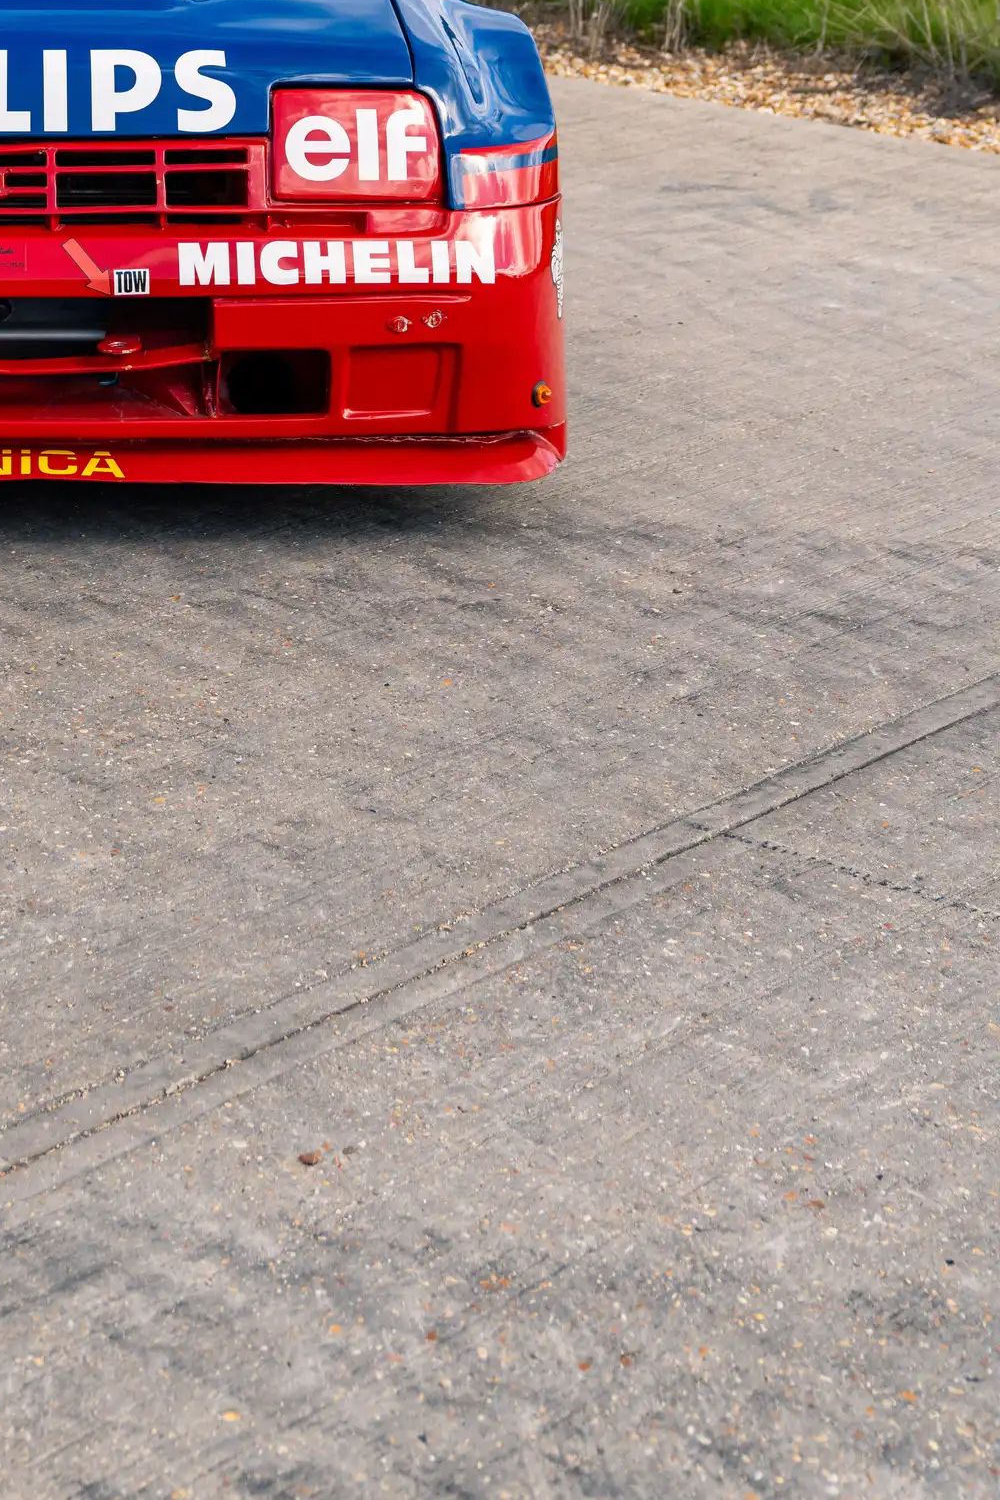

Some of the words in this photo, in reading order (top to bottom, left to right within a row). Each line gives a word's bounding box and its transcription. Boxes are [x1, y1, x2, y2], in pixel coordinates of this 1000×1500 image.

[284, 108, 427, 182] elf
[115, 270, 147, 294] TOW
[177, 240, 496, 285] MICHELIN
